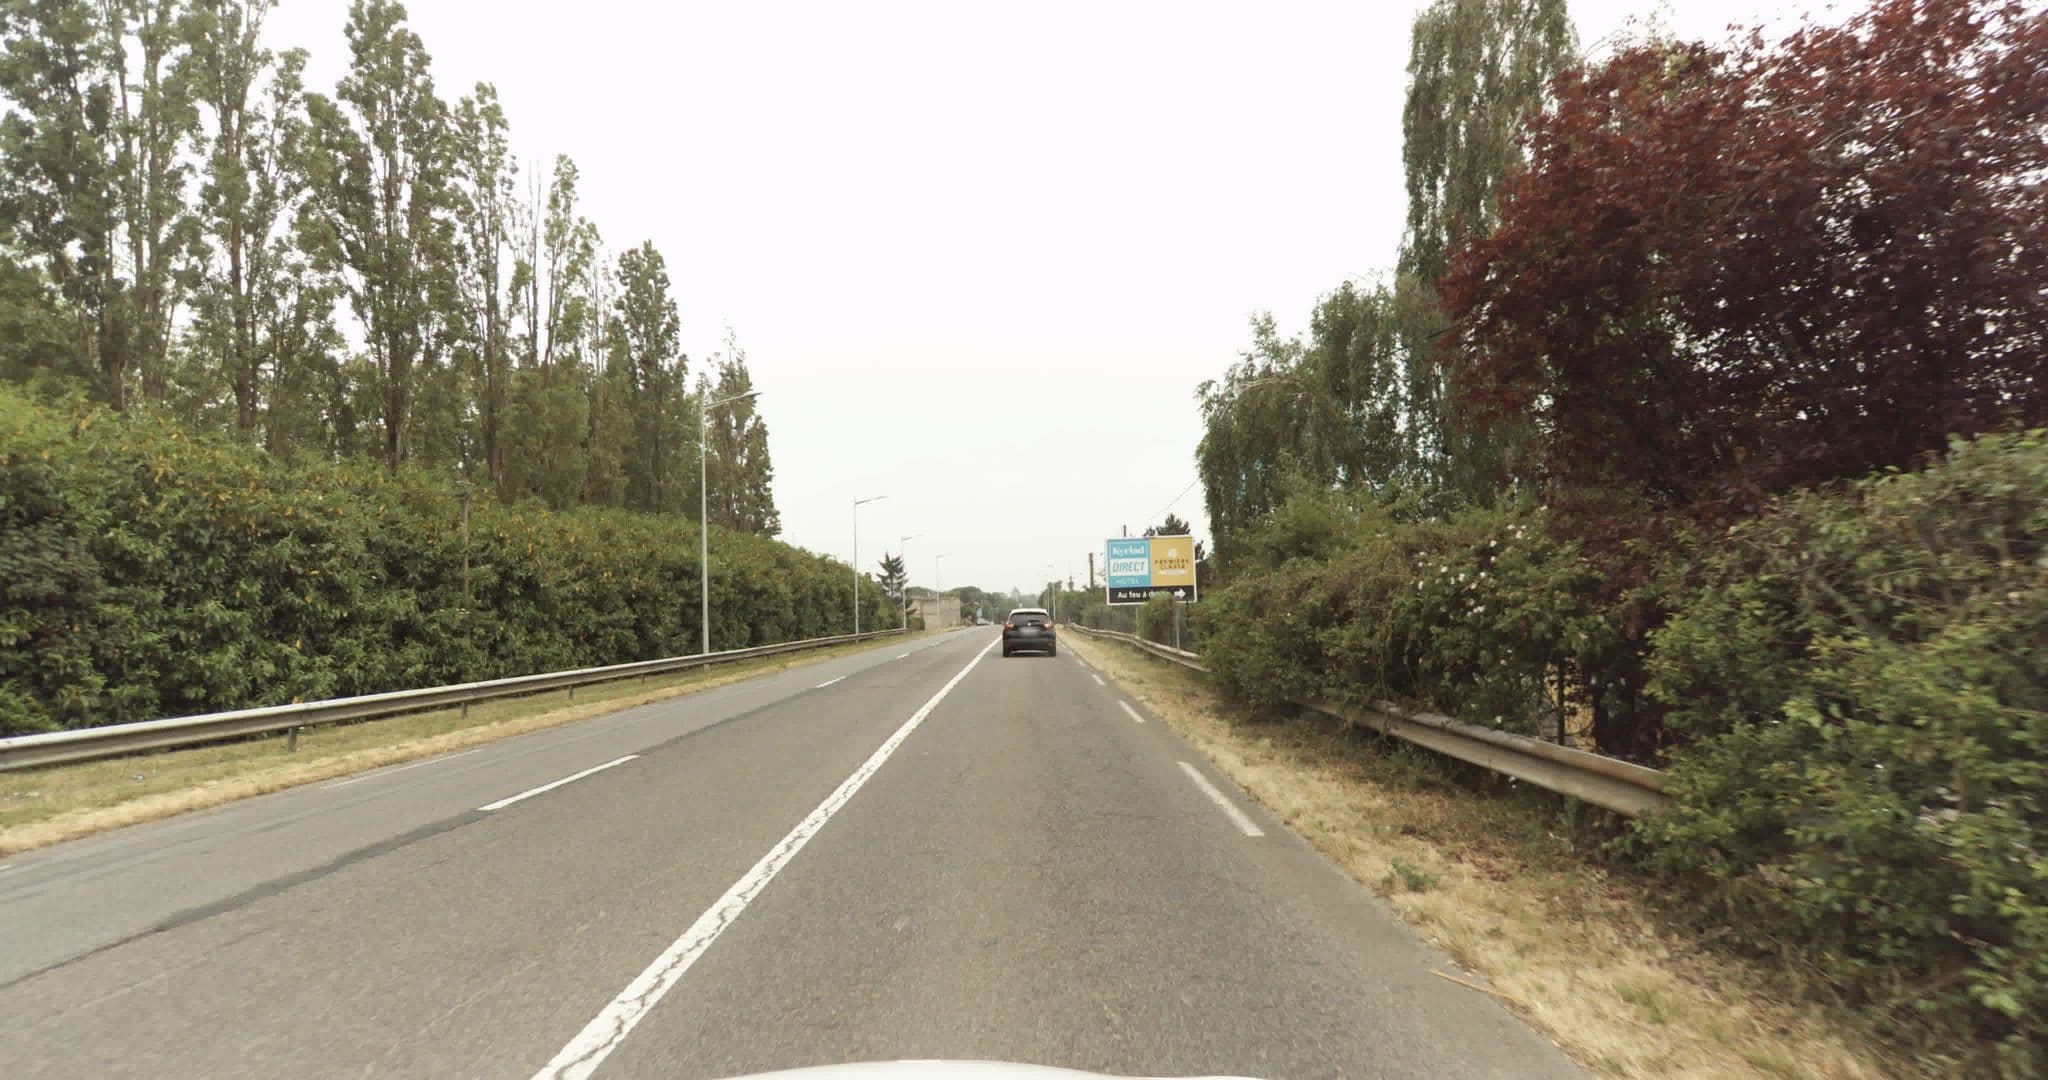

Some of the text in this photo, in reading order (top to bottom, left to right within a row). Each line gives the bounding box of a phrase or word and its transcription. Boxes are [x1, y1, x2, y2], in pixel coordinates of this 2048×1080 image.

[1112, 545, 1144, 557] Kyriad
[1113, 562, 1144, 573] DIRECT
[1128, 590, 1141, 598] feu
